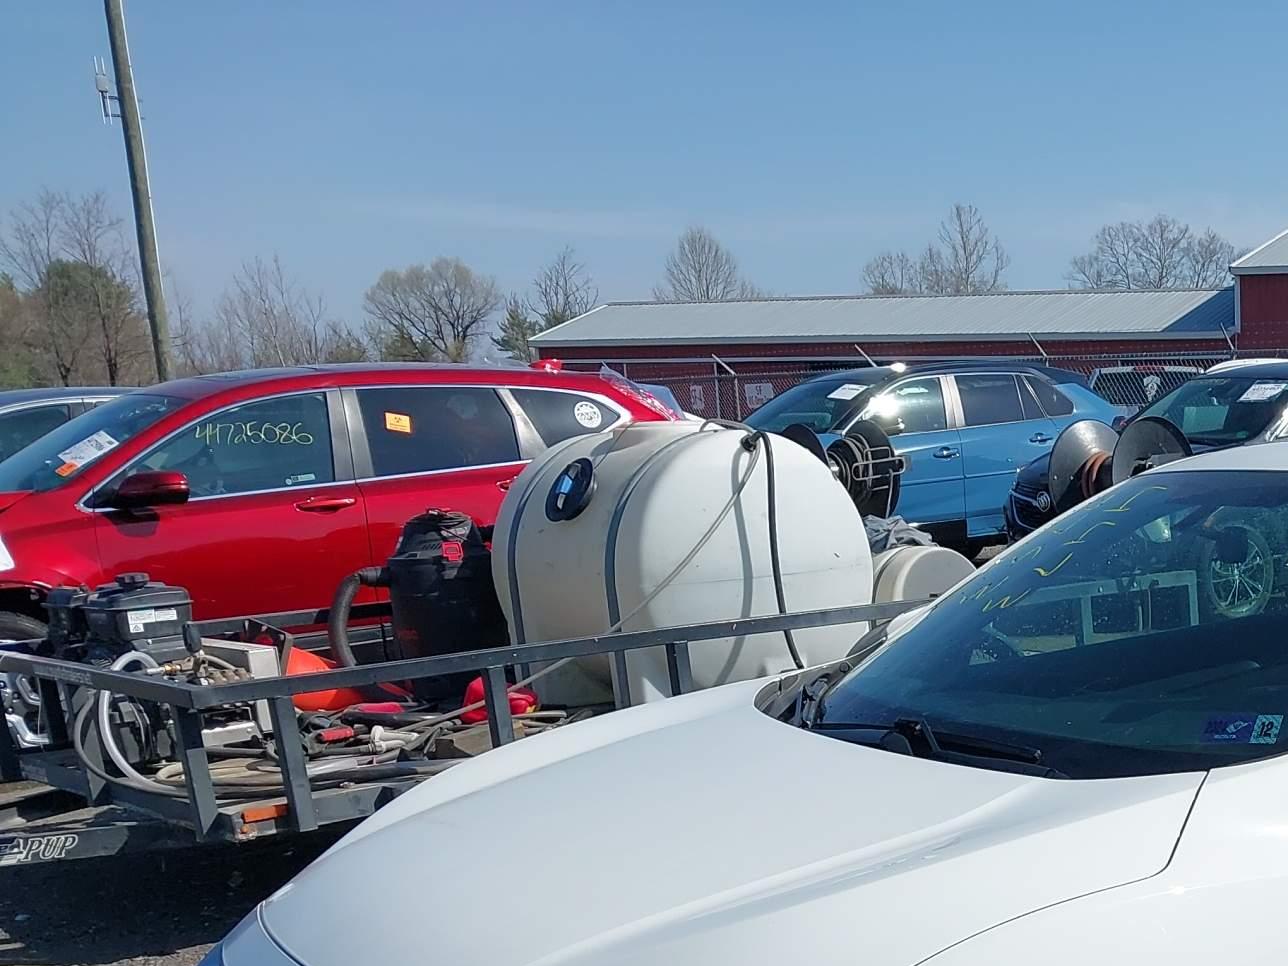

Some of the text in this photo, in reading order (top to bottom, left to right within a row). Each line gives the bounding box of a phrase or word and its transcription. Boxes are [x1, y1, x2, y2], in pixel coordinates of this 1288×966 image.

[195, 420, 313, 446] 44725086
[1259, 720, 1275, 738] 12
[19, 834, 79, 862] PUP
